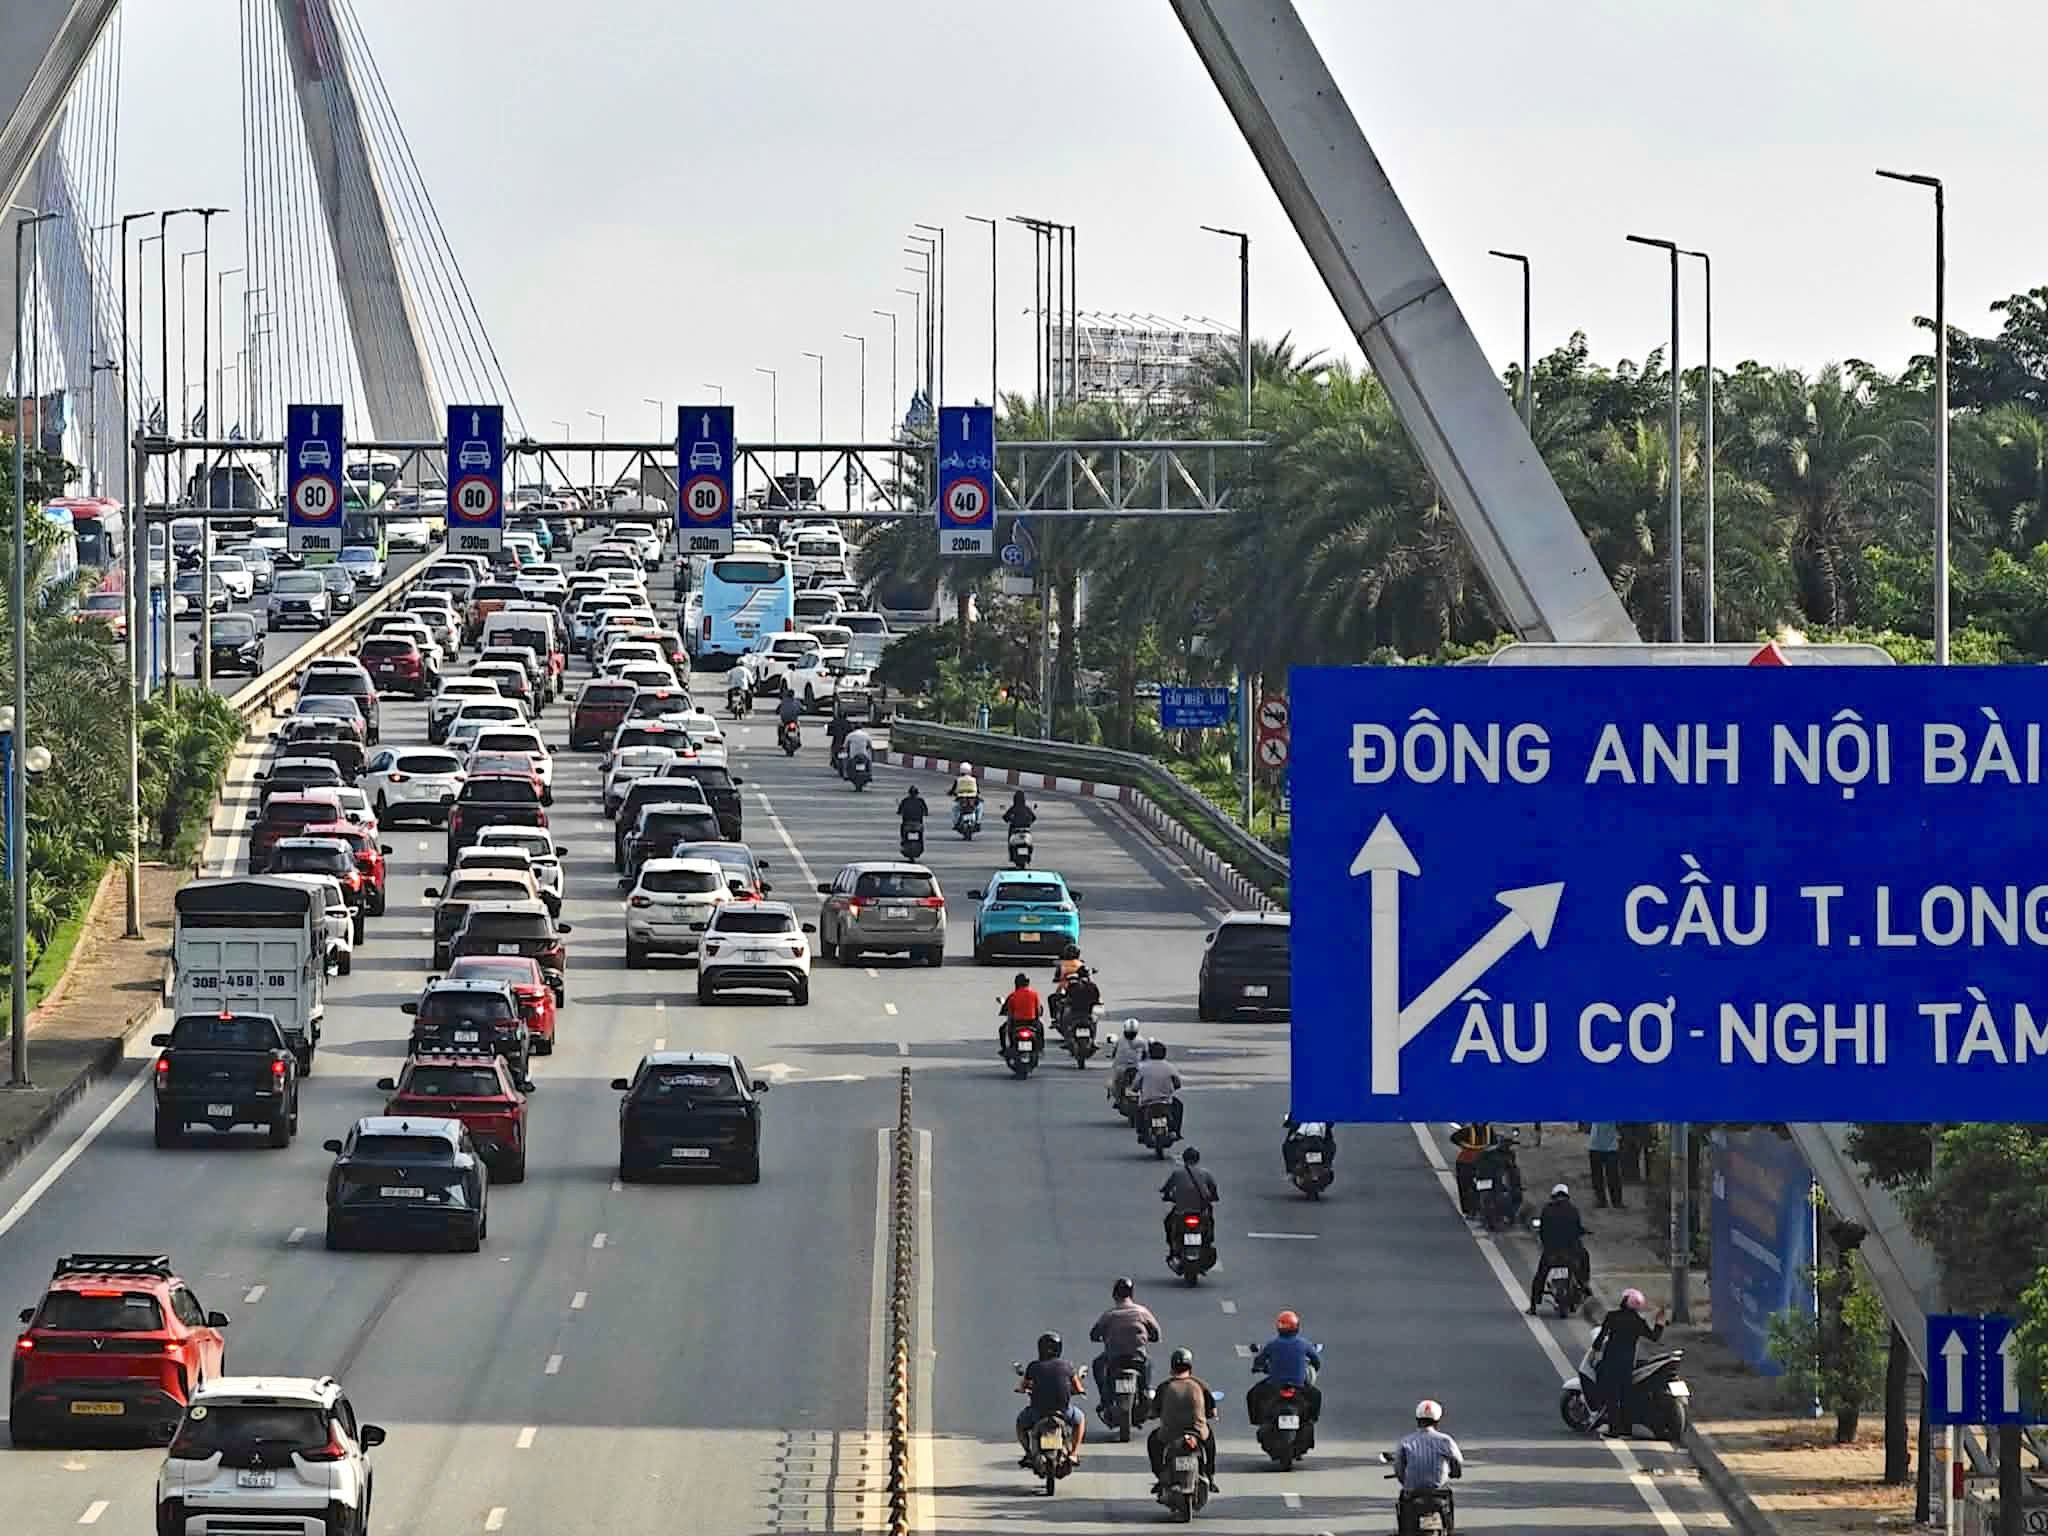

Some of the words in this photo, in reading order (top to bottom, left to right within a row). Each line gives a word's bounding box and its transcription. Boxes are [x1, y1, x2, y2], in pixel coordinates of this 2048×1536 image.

[304, 485, 327, 508] 80
[464, 488, 486, 508] 80
[695, 489, 716, 508] 80
[954, 492, 977, 511] 40
[301, 535, 330, 550] 200m
[460, 535, 489, 550] 200m
[689, 535, 720, 552] 200m
[951, 537, 981, 552] 200m
[1348, 707, 1551, 785] ĐÔNG
[1585, 723, 1739, 784] ANH
[1773, 707, 1890, 800] NỘI
[1923, 706, 2040, 784] BÀI
[1625, 854, 1767, 946] CẦU
[1450, 988, 1547, 1064] ÂU
[1918, 986, 2048, 1064] TÀM
